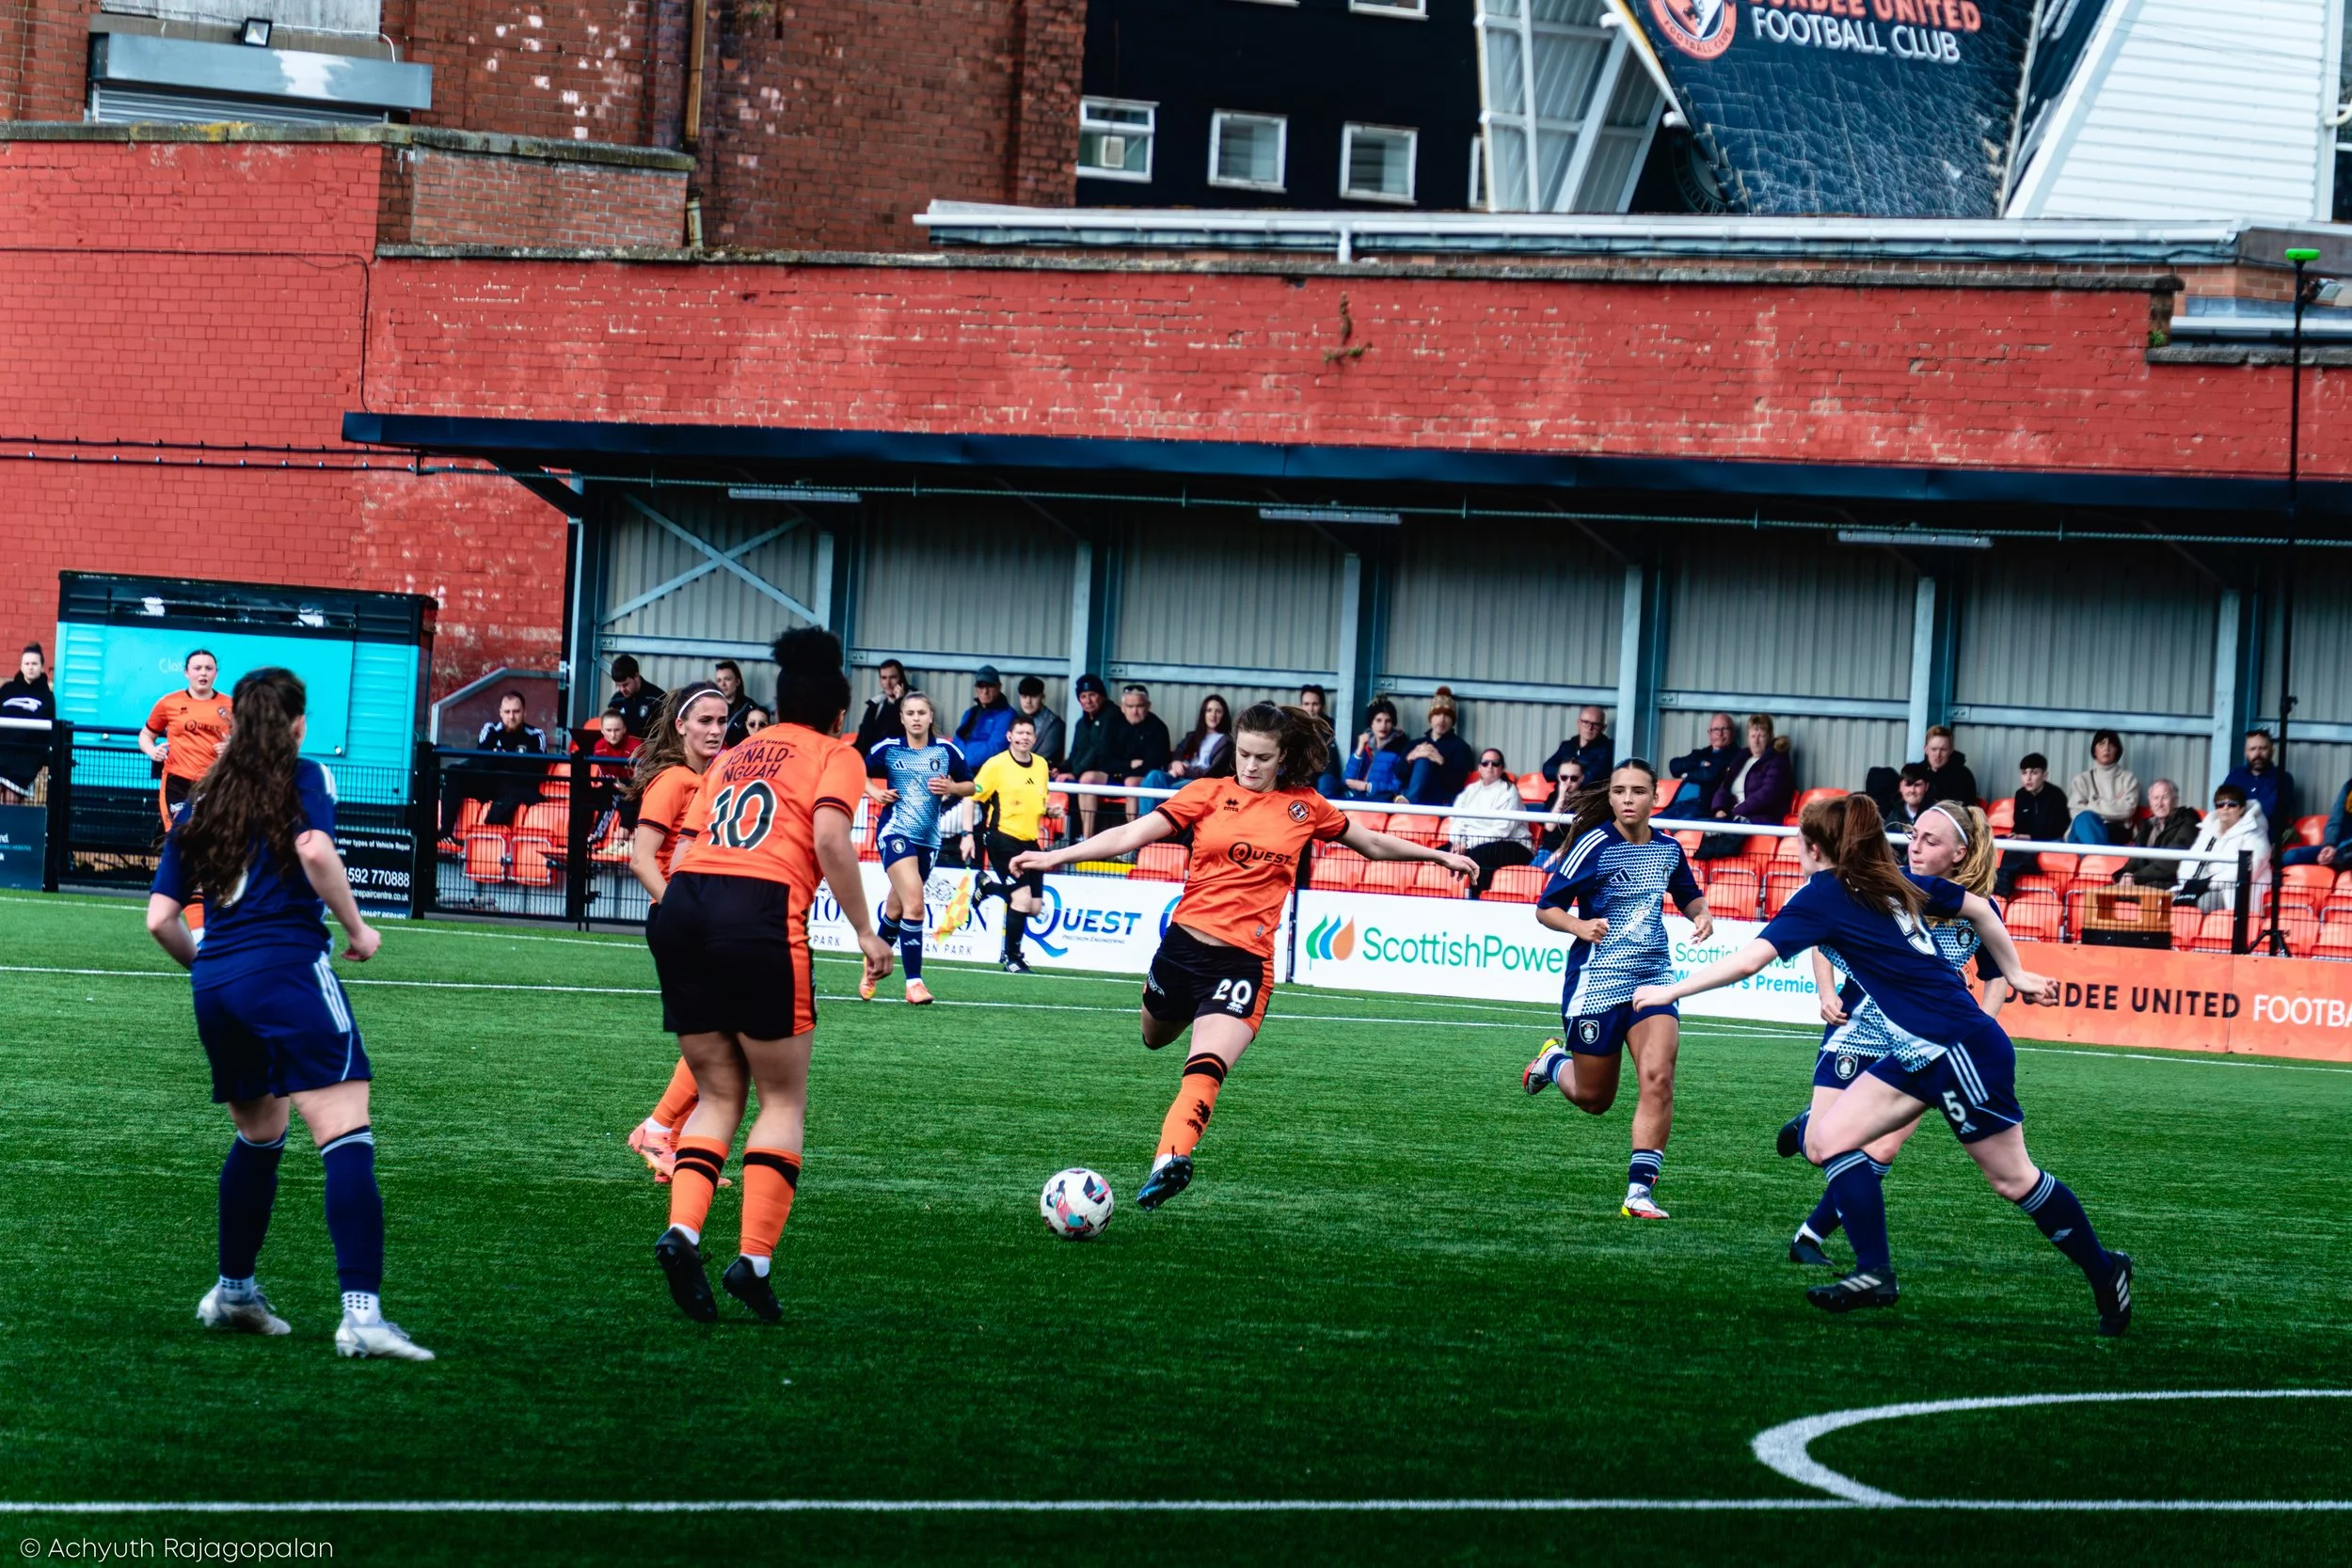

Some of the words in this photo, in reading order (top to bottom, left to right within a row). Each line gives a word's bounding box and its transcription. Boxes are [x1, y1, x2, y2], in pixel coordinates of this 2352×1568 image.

[1751, 6, 1887, 55] FOOTBALL
[1890, 24, 1961, 64] CLUB
[722, 764, 781, 784] NGUAH
[707, 779, 778, 851] 10
[375, 840, 394, 849] Vehicle
[1228, 842, 1293, 870] QUEST
[371, 869, 410, 887] 770888
[1024, 885, 1141, 958] QUEST
[945, 943, 972, 956] PARK
[1212, 978, 1252, 1006] 20
[2130, 986, 2241, 1019] UNITED
[1942, 1090, 1966, 1122] 5
